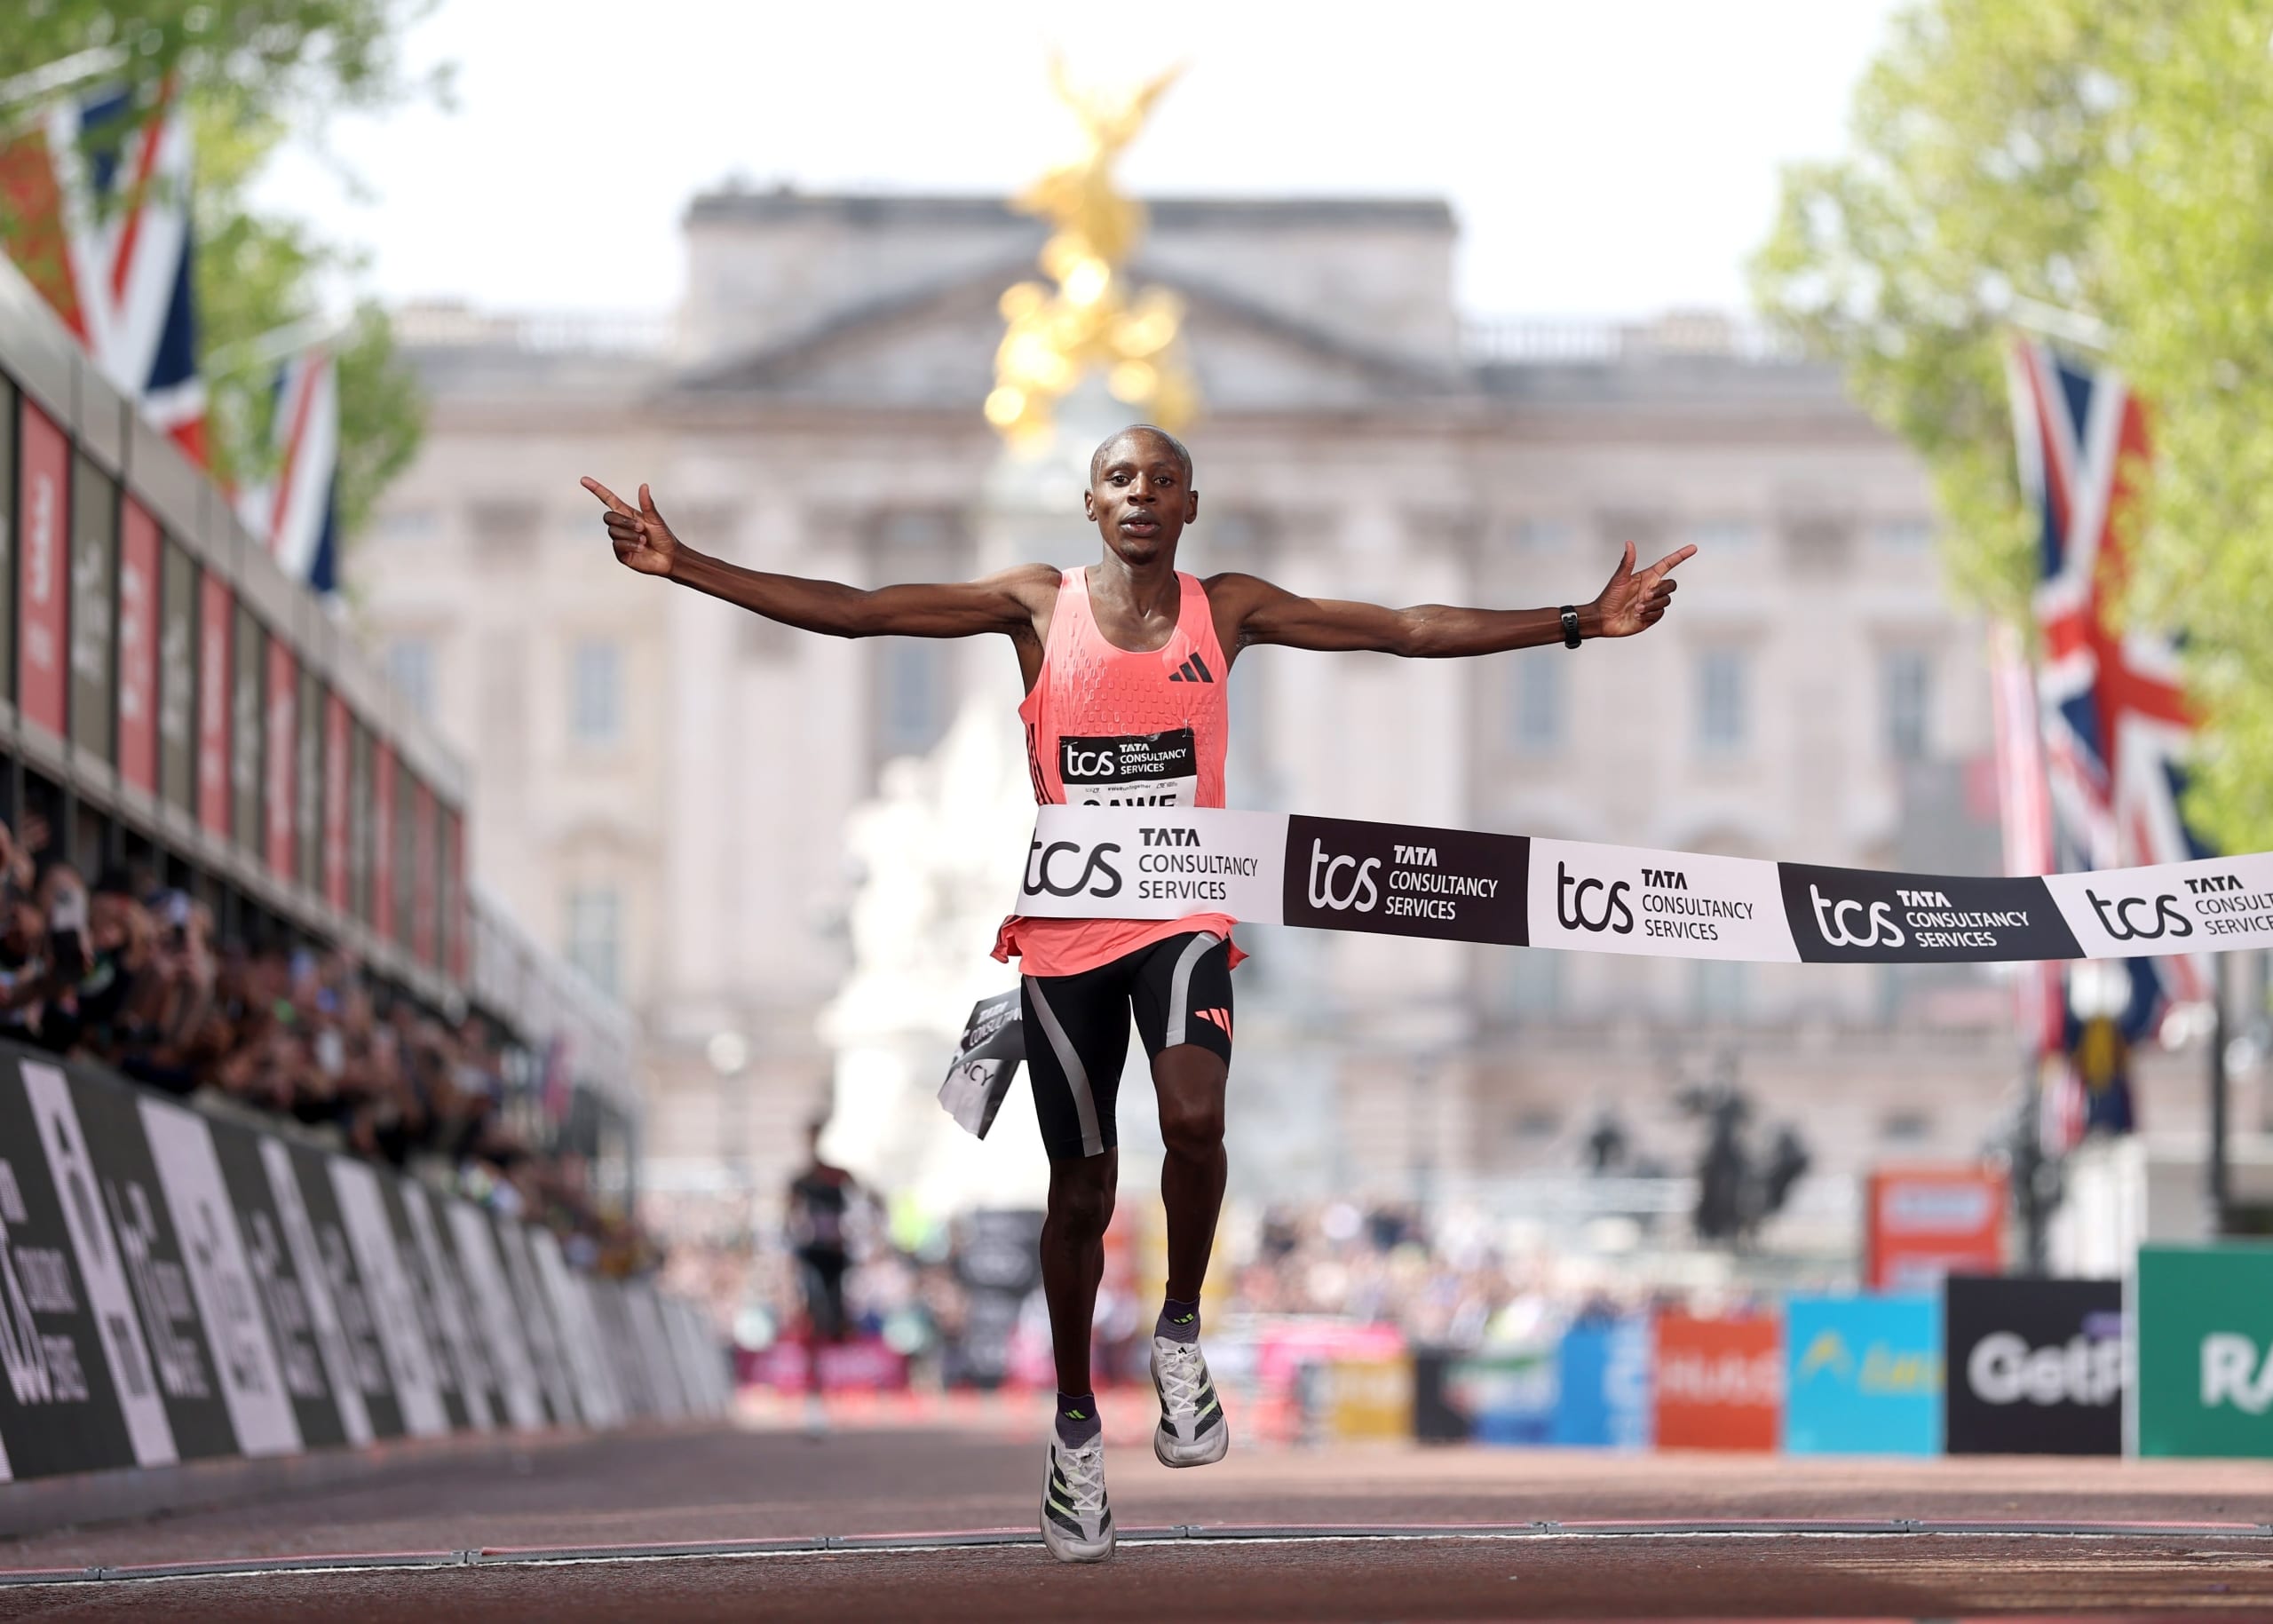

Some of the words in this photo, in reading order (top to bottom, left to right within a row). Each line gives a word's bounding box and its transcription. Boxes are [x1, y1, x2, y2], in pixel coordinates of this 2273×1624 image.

[1119, 743, 1150, 753] TATA
[1120, 749, 1187, 764] CONSULTANCY
[1067, 745, 1114, 776] tcs
[1121, 764, 1164, 775] SERVICES
[1139, 828, 1200, 847] TATA
[1138, 854, 1258, 877] CONSULTANCY
[1393, 844, 1438, 867] TATA
[1308, 837, 1382, 913] tcs
[1389, 870, 1499, 899] CONSULTANCY
[1641, 868, 1688, 890] TATA
[2183, 875, 2245, 894] TATA
[1138, 880, 1226, 900] SERVICES
[1557, 860, 1634, 934] tcs
[1896, 890, 1952, 907] TATA
[1385, 895, 1456, 920] SERVICES
[1642, 893, 1754, 920] CONSULTANCY
[1810, 883, 1905, 947] tcs
[2085, 889, 2193, 940] tcs
[1644, 919, 1718, 941] SERVICES
[1905, 910, 2030, 928] CONSULTANCY
[1914, 931, 1998, 947] SERVICES
